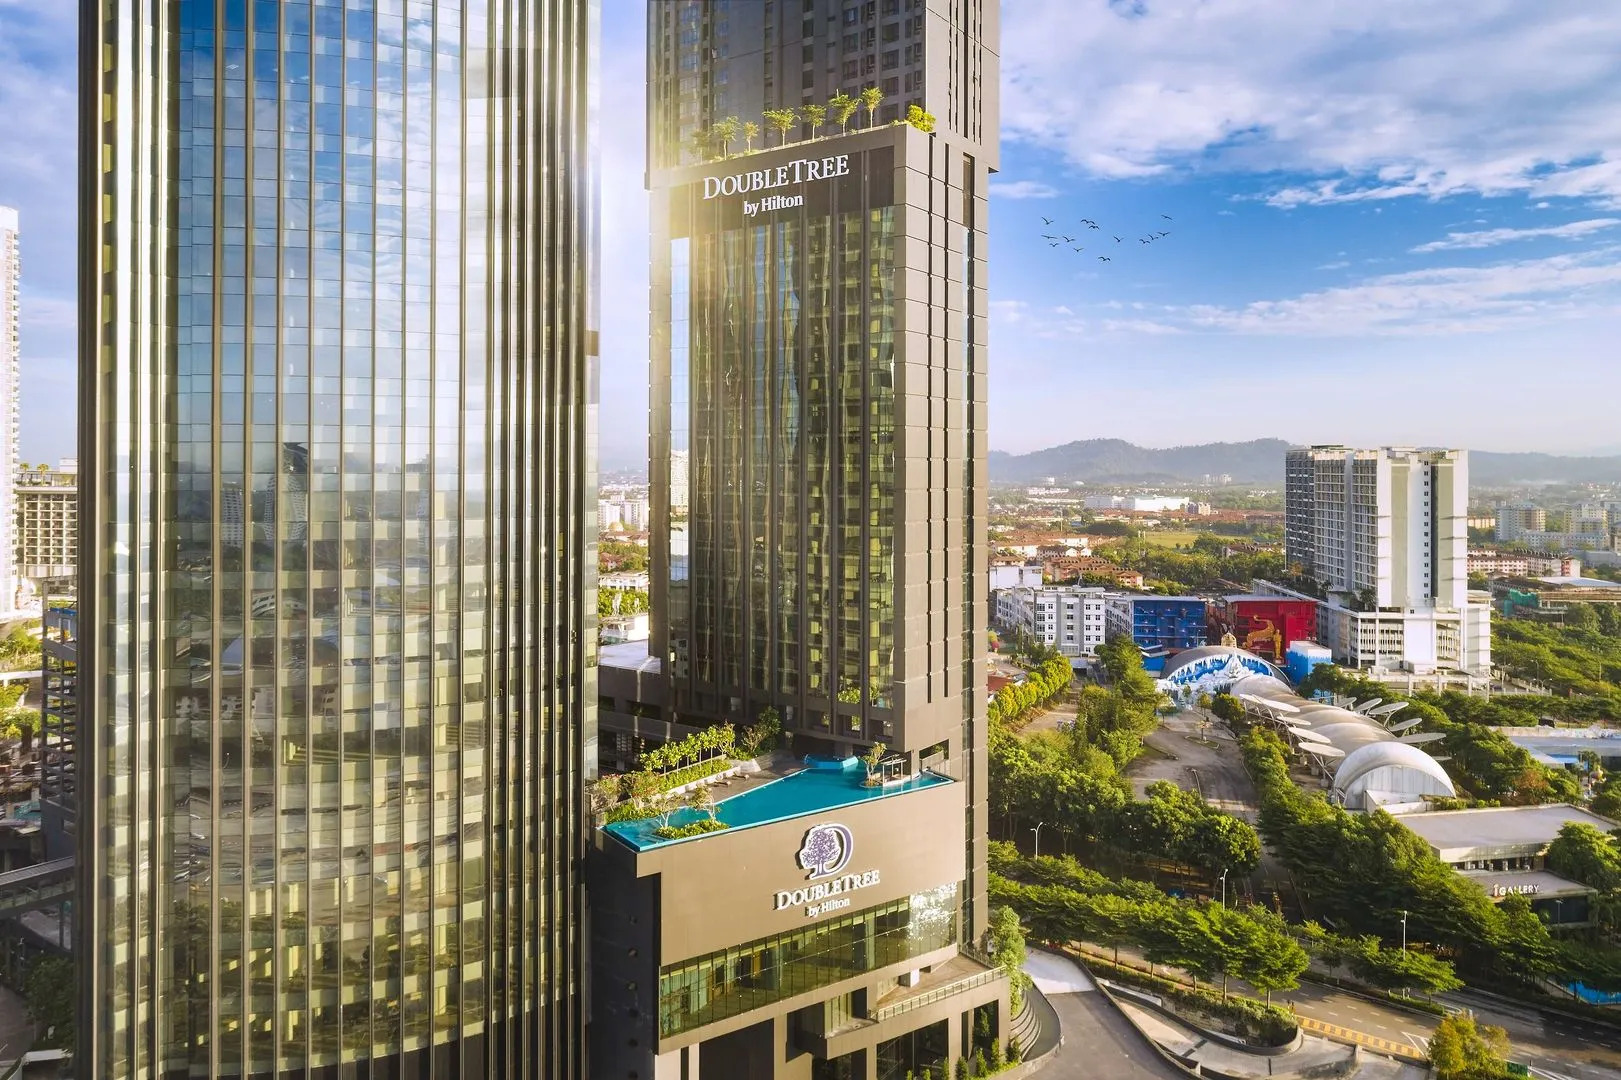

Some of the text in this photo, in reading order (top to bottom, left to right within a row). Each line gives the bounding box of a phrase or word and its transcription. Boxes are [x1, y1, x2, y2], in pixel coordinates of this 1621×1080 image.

[743, 195, 803, 217] by Hilton
[808, 898, 850, 917] by Hilton
